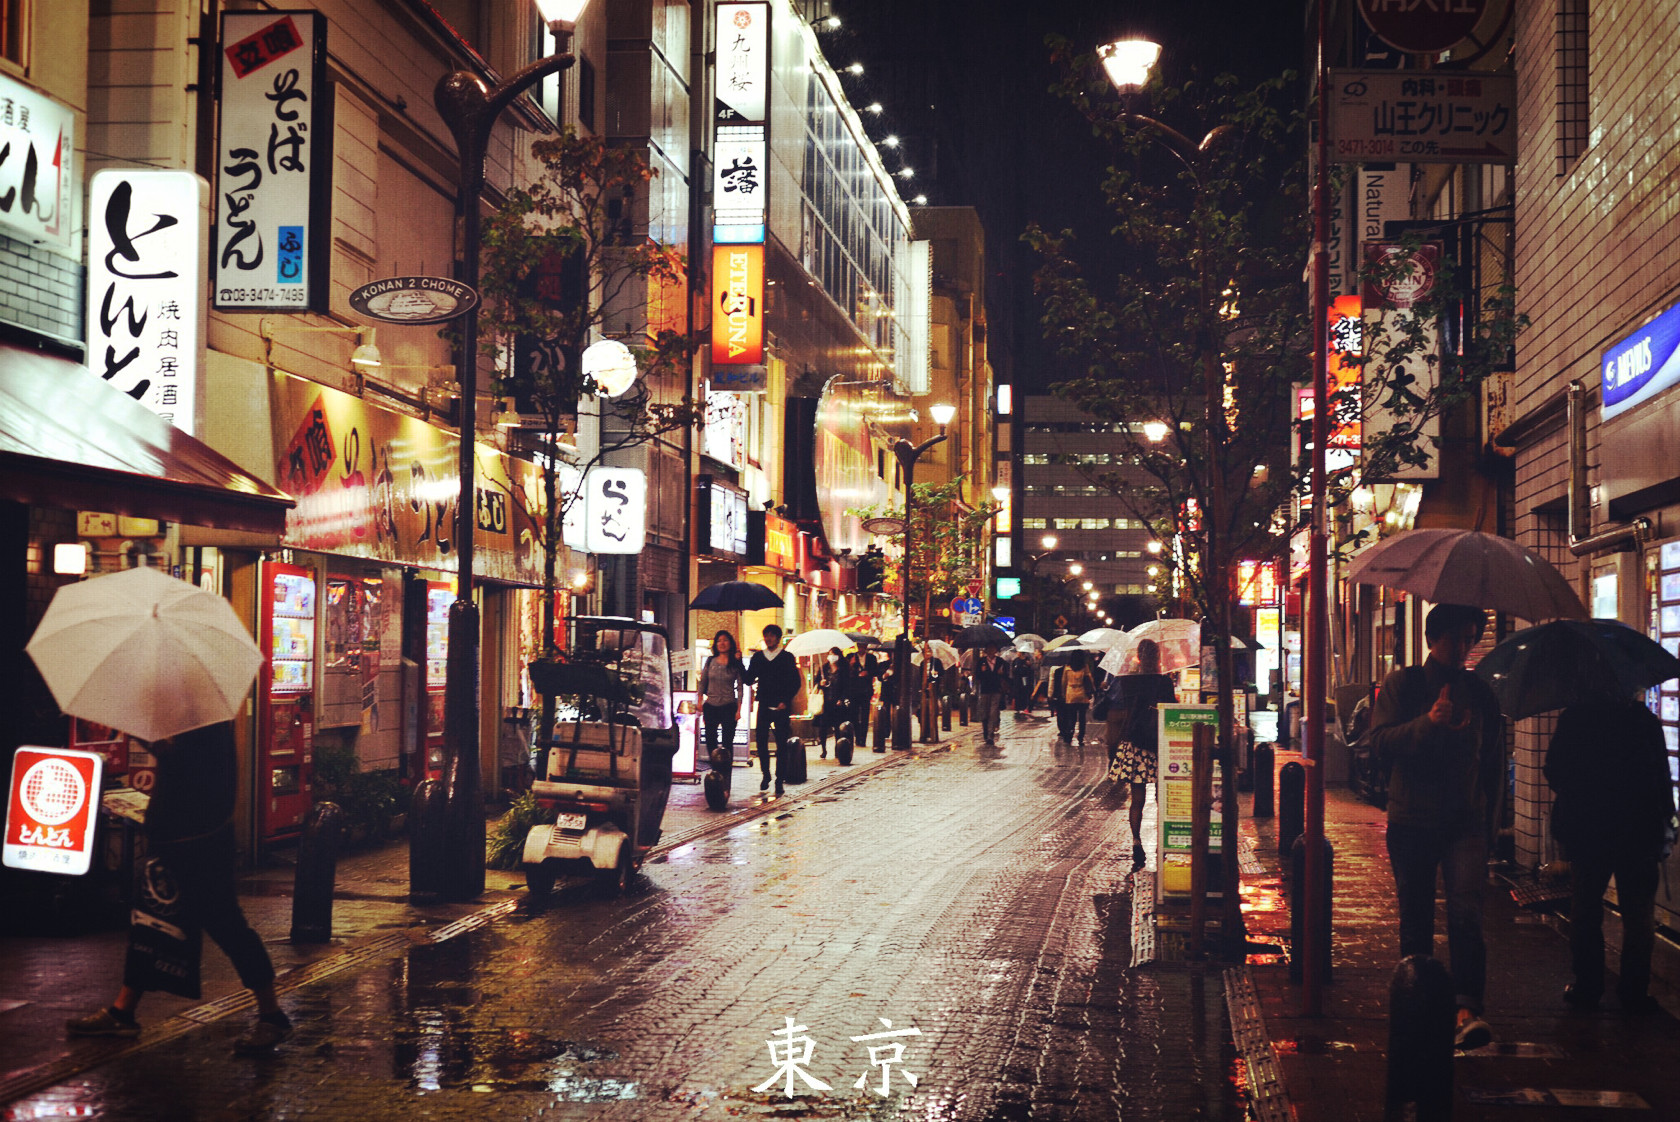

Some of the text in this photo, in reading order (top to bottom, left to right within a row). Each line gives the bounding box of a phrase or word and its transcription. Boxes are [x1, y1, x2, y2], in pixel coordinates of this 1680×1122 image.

[265, 68, 308, 174] そば
[718, 109, 735, 120] 4F
[1374, 101, 1510, 136] 山王クリニック
[1400, 140, 1440, 155] この先
[221, 148, 263, 270] うどん
[1366, 175, 1384, 240] Natural
[280, 231, 302, 278] ふじ
[361, 278, 464, 300] KONAN 2 CHOME
[728, 252, 748, 358] ETERUNA
[19, 824, 75, 848] とんとん
